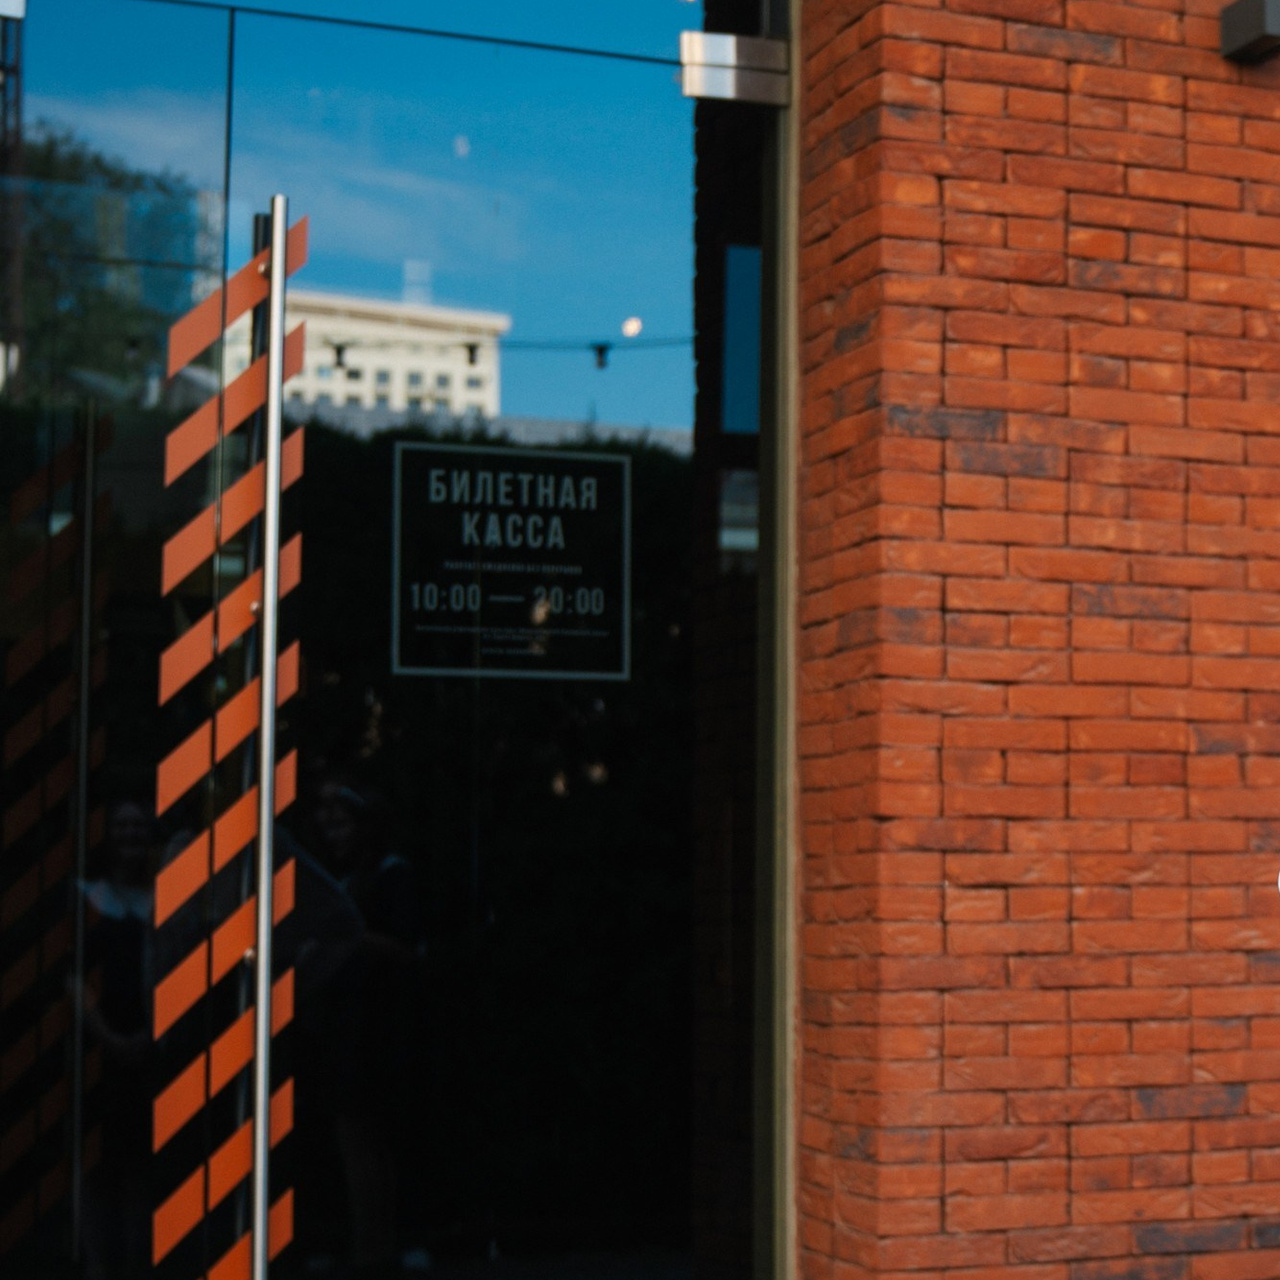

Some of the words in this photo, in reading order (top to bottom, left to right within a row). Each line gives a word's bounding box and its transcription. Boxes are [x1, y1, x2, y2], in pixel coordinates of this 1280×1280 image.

[428, 469, 598, 510] БИЛЕТНАЯ
[462, 511, 566, 550] КАССА
[410, 581, 482, 612] 10:00
